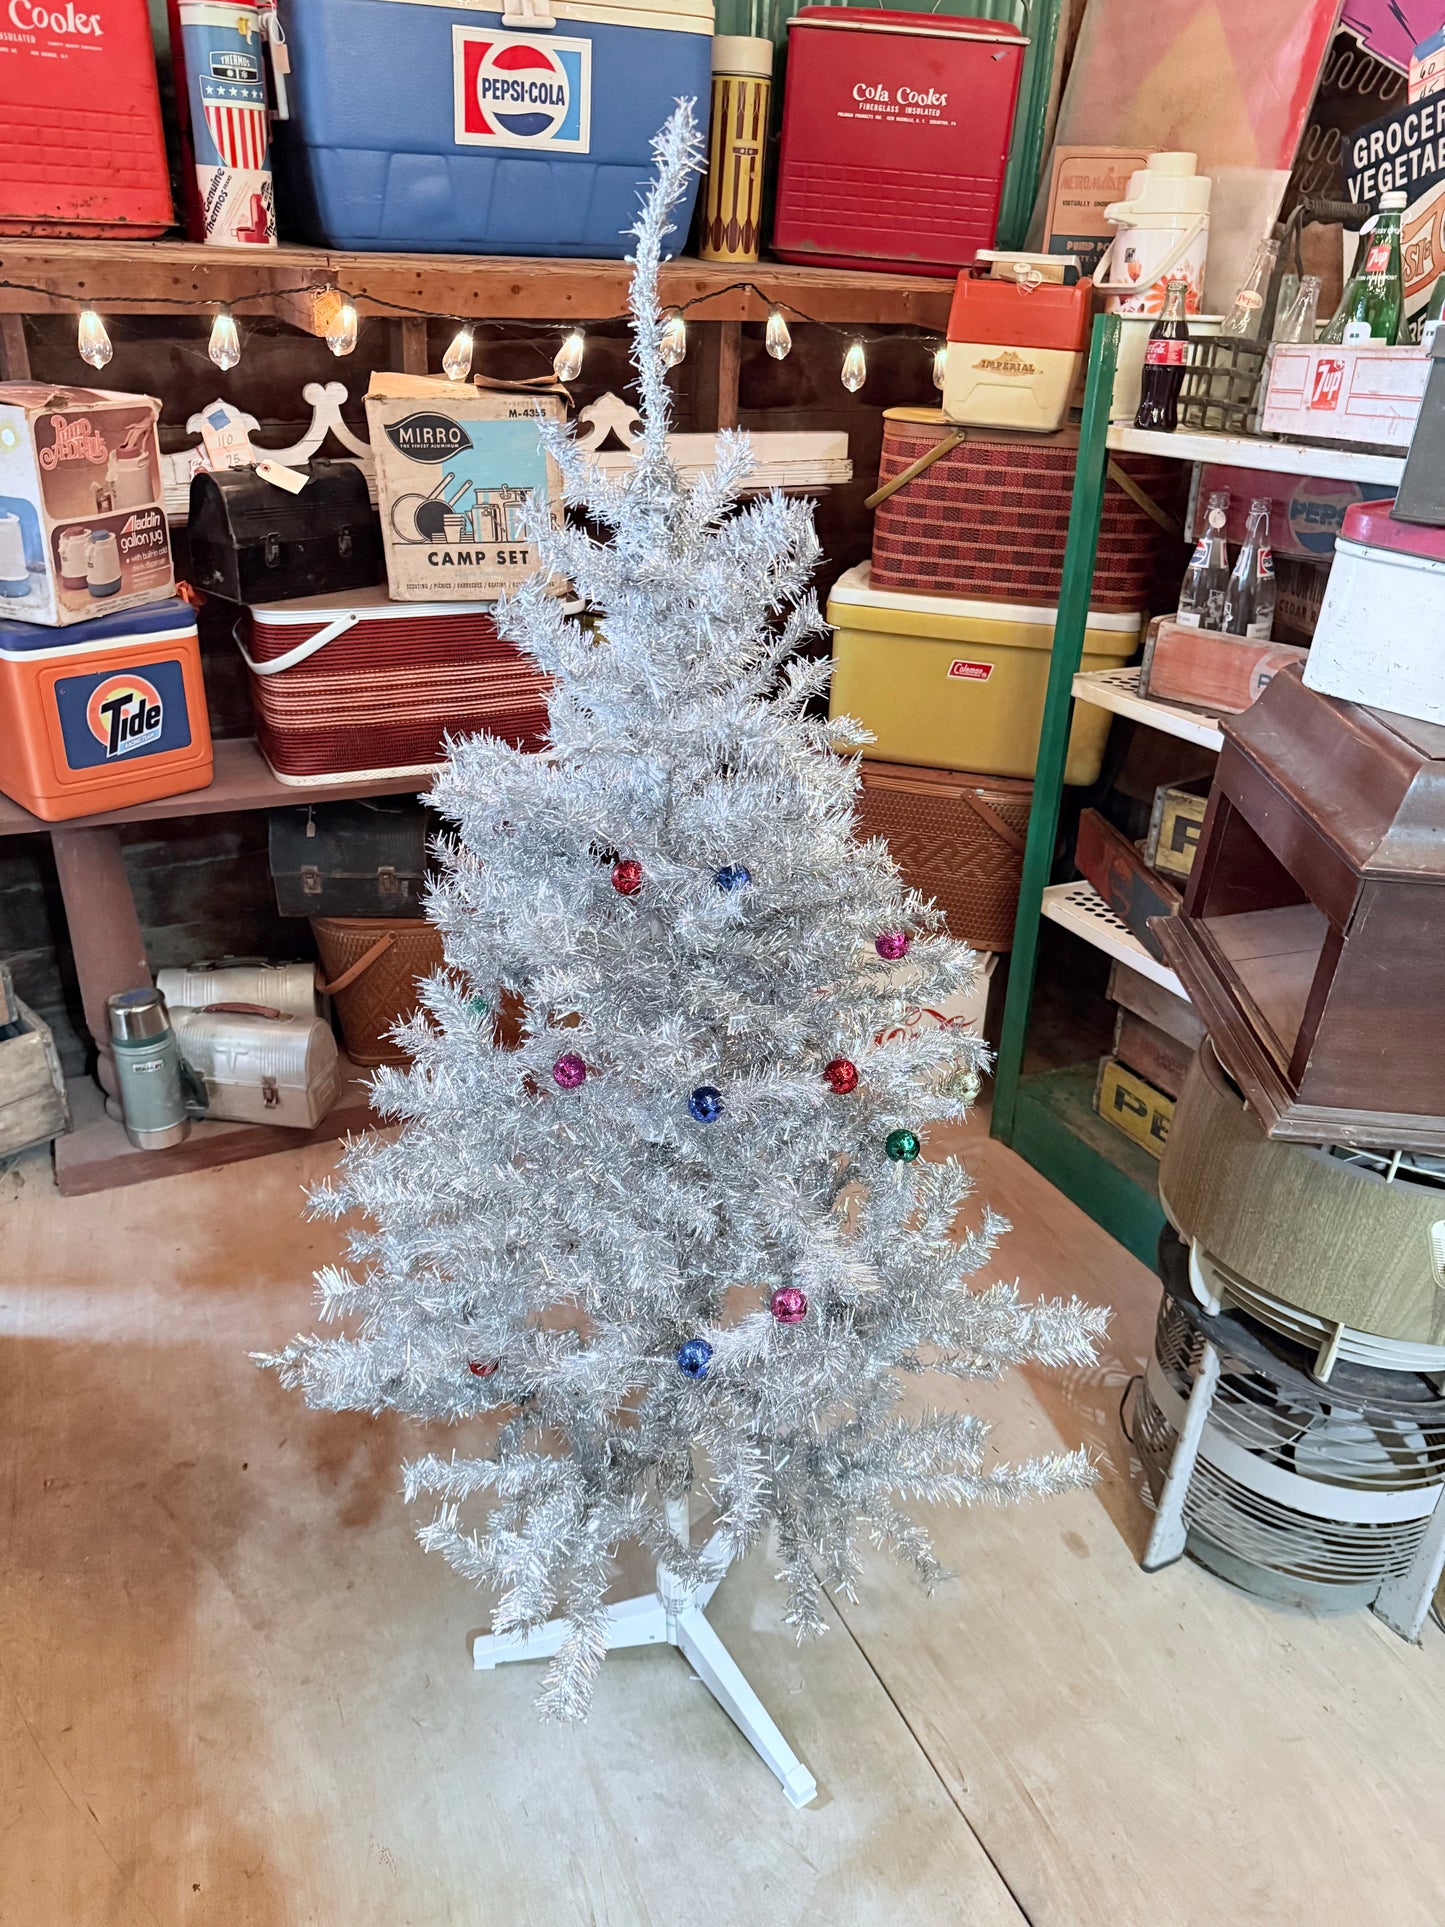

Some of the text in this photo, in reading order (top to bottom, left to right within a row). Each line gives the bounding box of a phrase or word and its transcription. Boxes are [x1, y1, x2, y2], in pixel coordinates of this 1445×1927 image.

[8, 0, 104, 36] Cooler
[220, 54, 250, 67] THERMOS
[852, 83, 948, 107] Cola Cooler
[859, 102, 941, 117] FIBERGLASS INSULATED
[981, 359, 1035, 373] IMPERIAL
[1312, 363, 1342, 401] 7up
[399, 427, 461, 444] MIRRO
[120, 511, 161, 534] Aladdin
[120, 530, 163, 553] gallon jug
[428, 550, 529, 566] CAMP SET
[953, 663, 984, 675] Coleman
[101, 693, 161, 755] Tide
